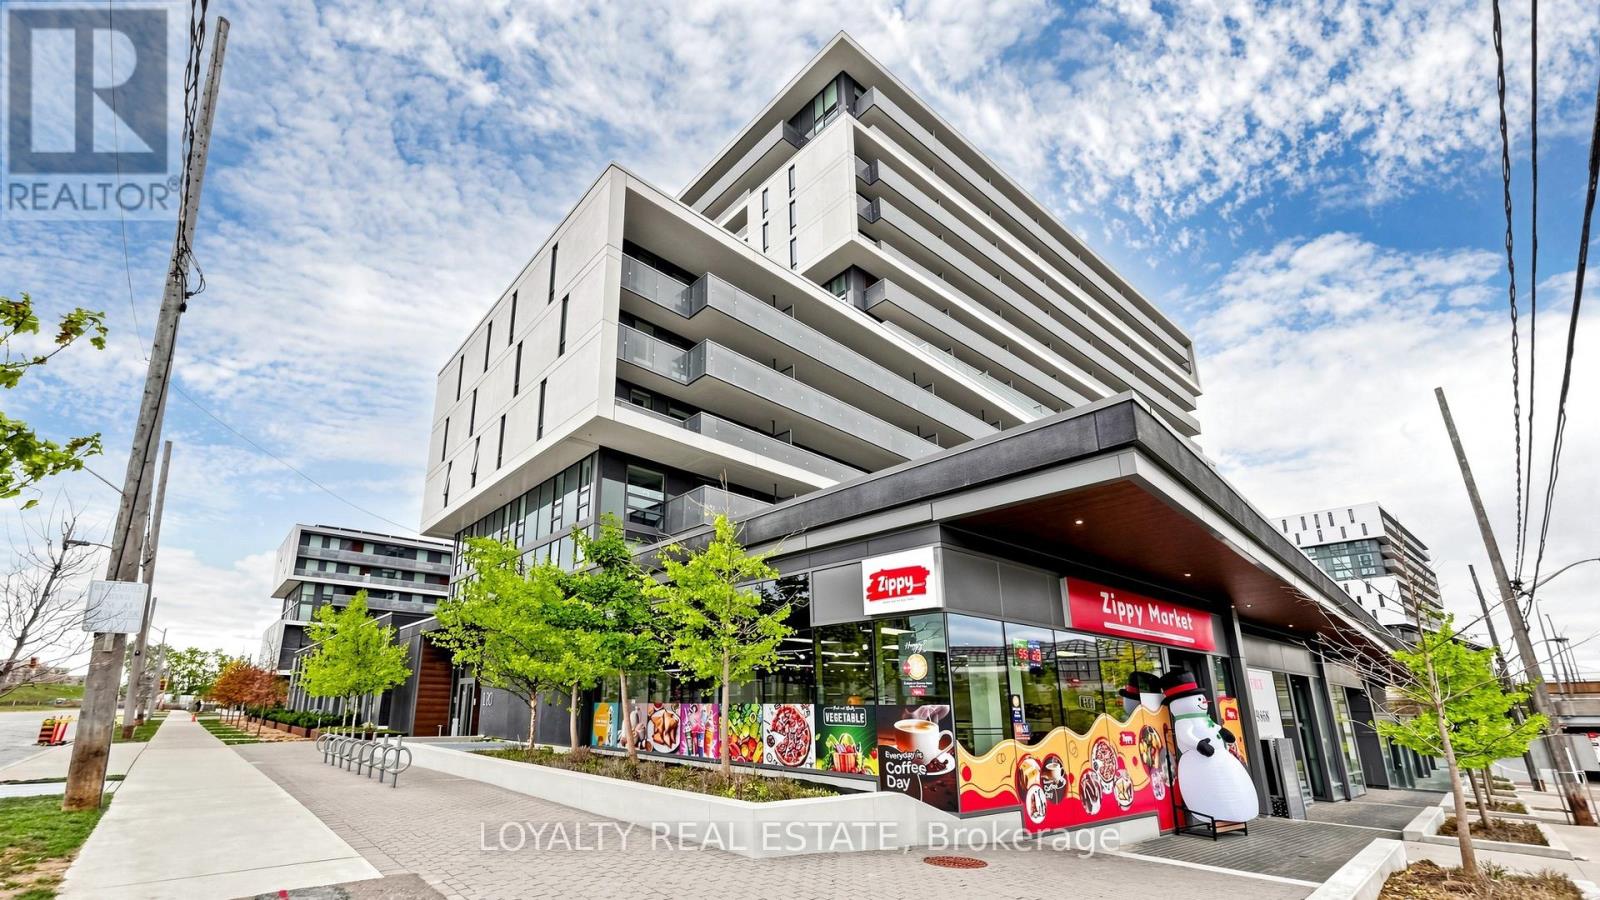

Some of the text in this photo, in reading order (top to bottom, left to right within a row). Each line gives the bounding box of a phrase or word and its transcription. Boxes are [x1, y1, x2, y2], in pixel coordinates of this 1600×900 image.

[877, 575, 925, 596] Zippy
[1100, 591, 1193, 630] Zippy Market
[825, 711, 865, 724] VEGETABLE
[884, 750, 915, 761] Everyday
[885, 761, 928, 776] Coffee
[886, 774, 911, 792] Day
